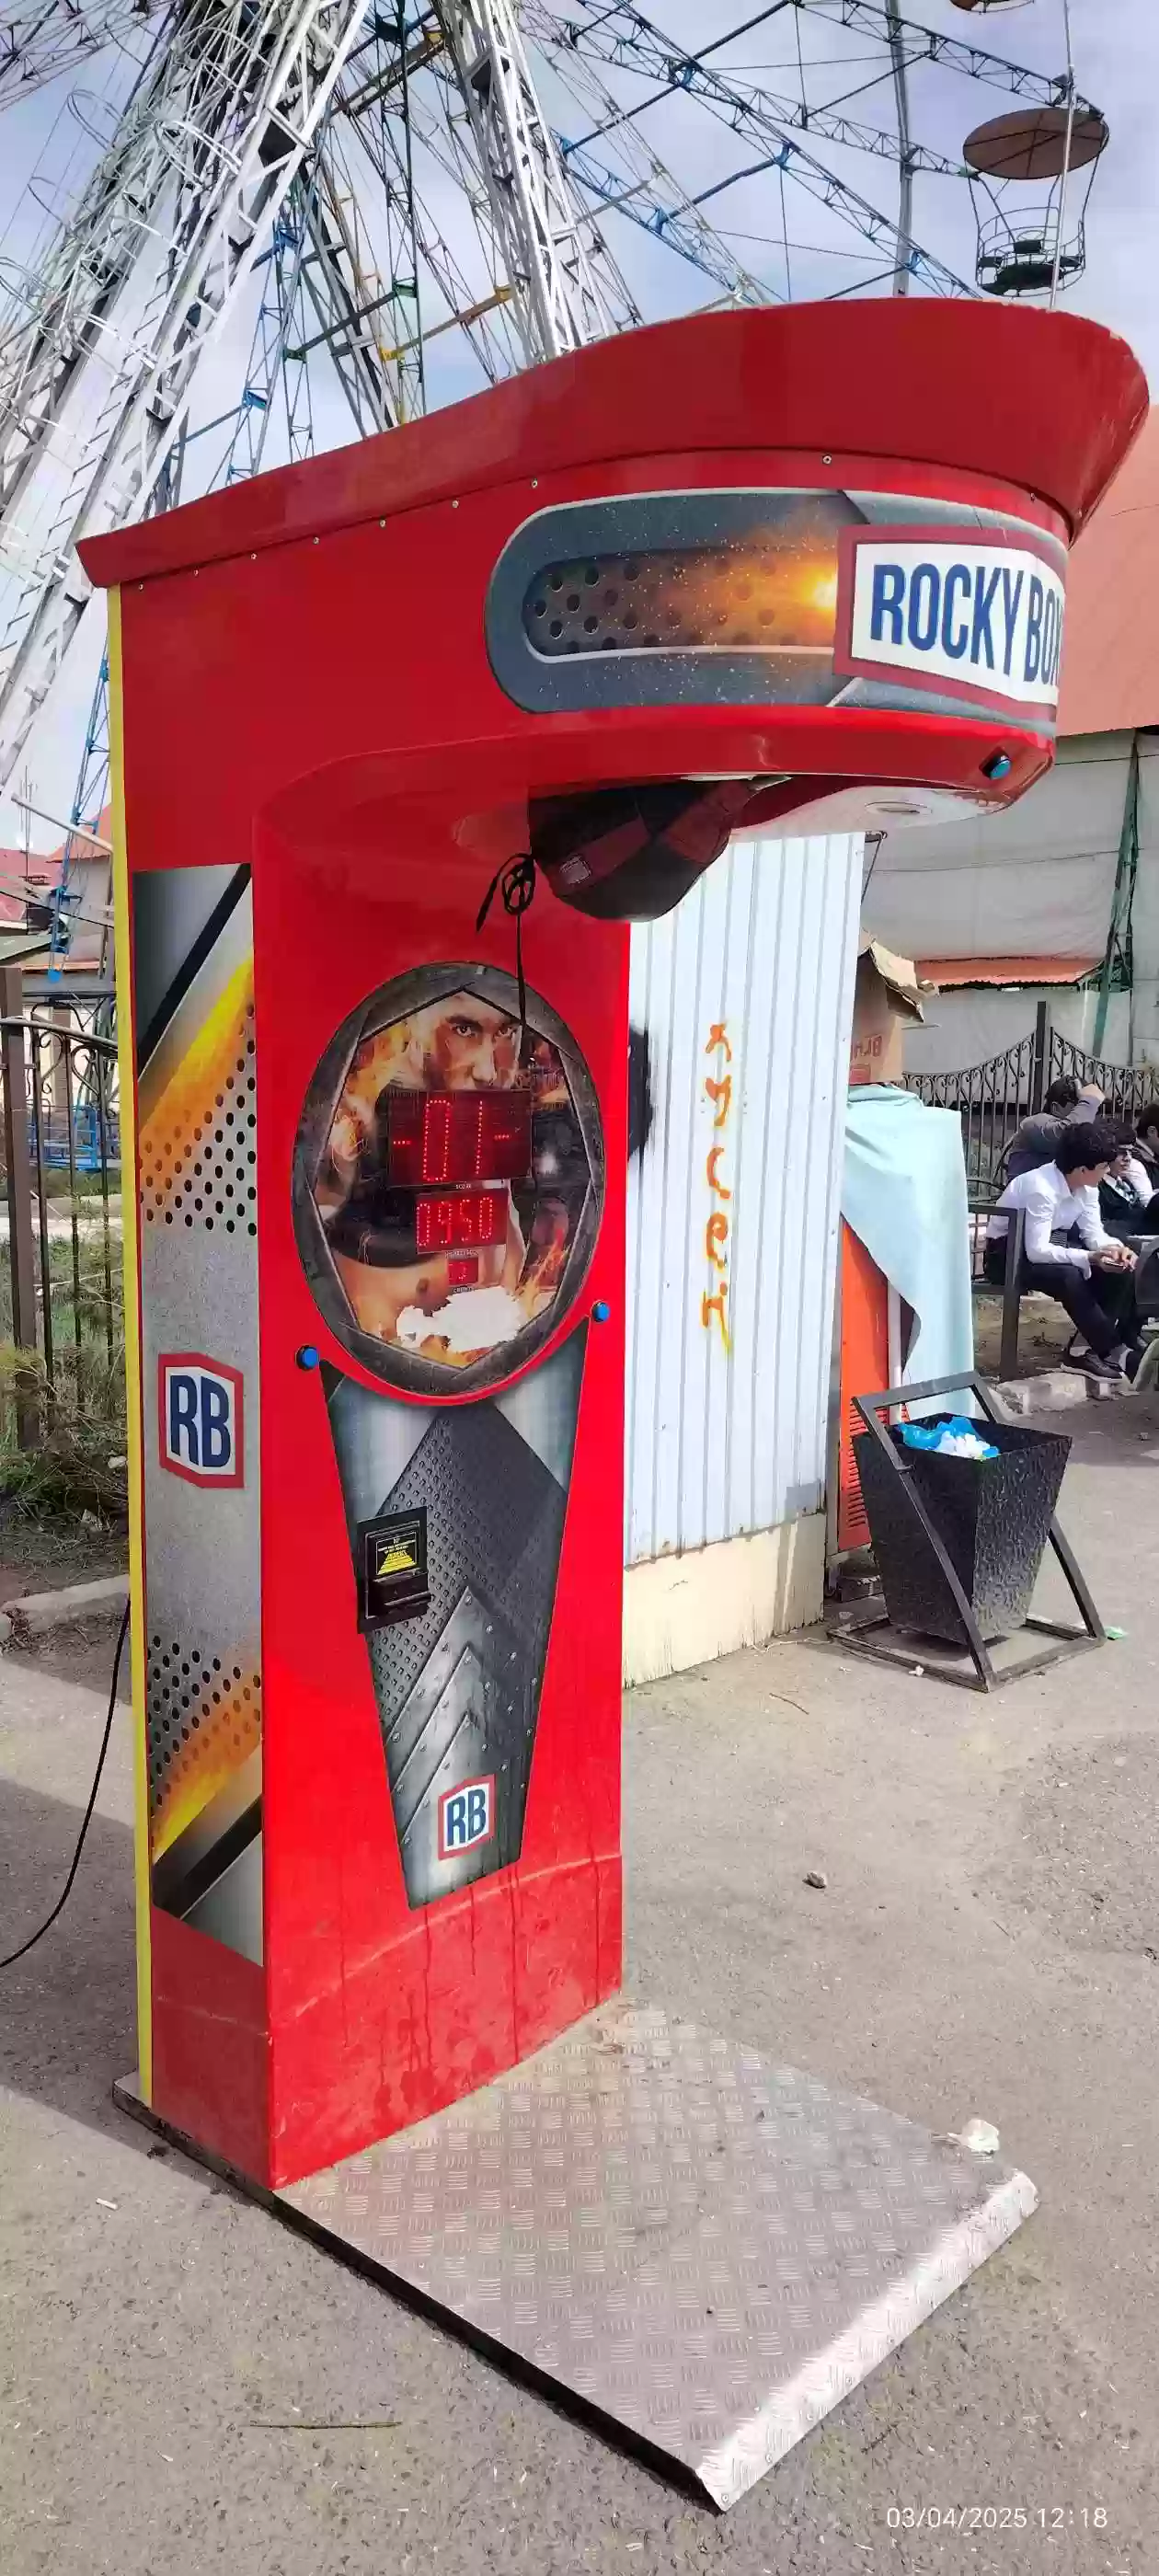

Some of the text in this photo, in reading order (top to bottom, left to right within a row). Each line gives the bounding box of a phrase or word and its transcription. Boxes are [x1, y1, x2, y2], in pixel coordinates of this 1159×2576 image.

[871, 563, 1024, 675] ROCKY
[417, 1197, 493, 1247] 0950
[170, 1374, 231, 1467] RB
[447, 1789, 487, 1846] RB
